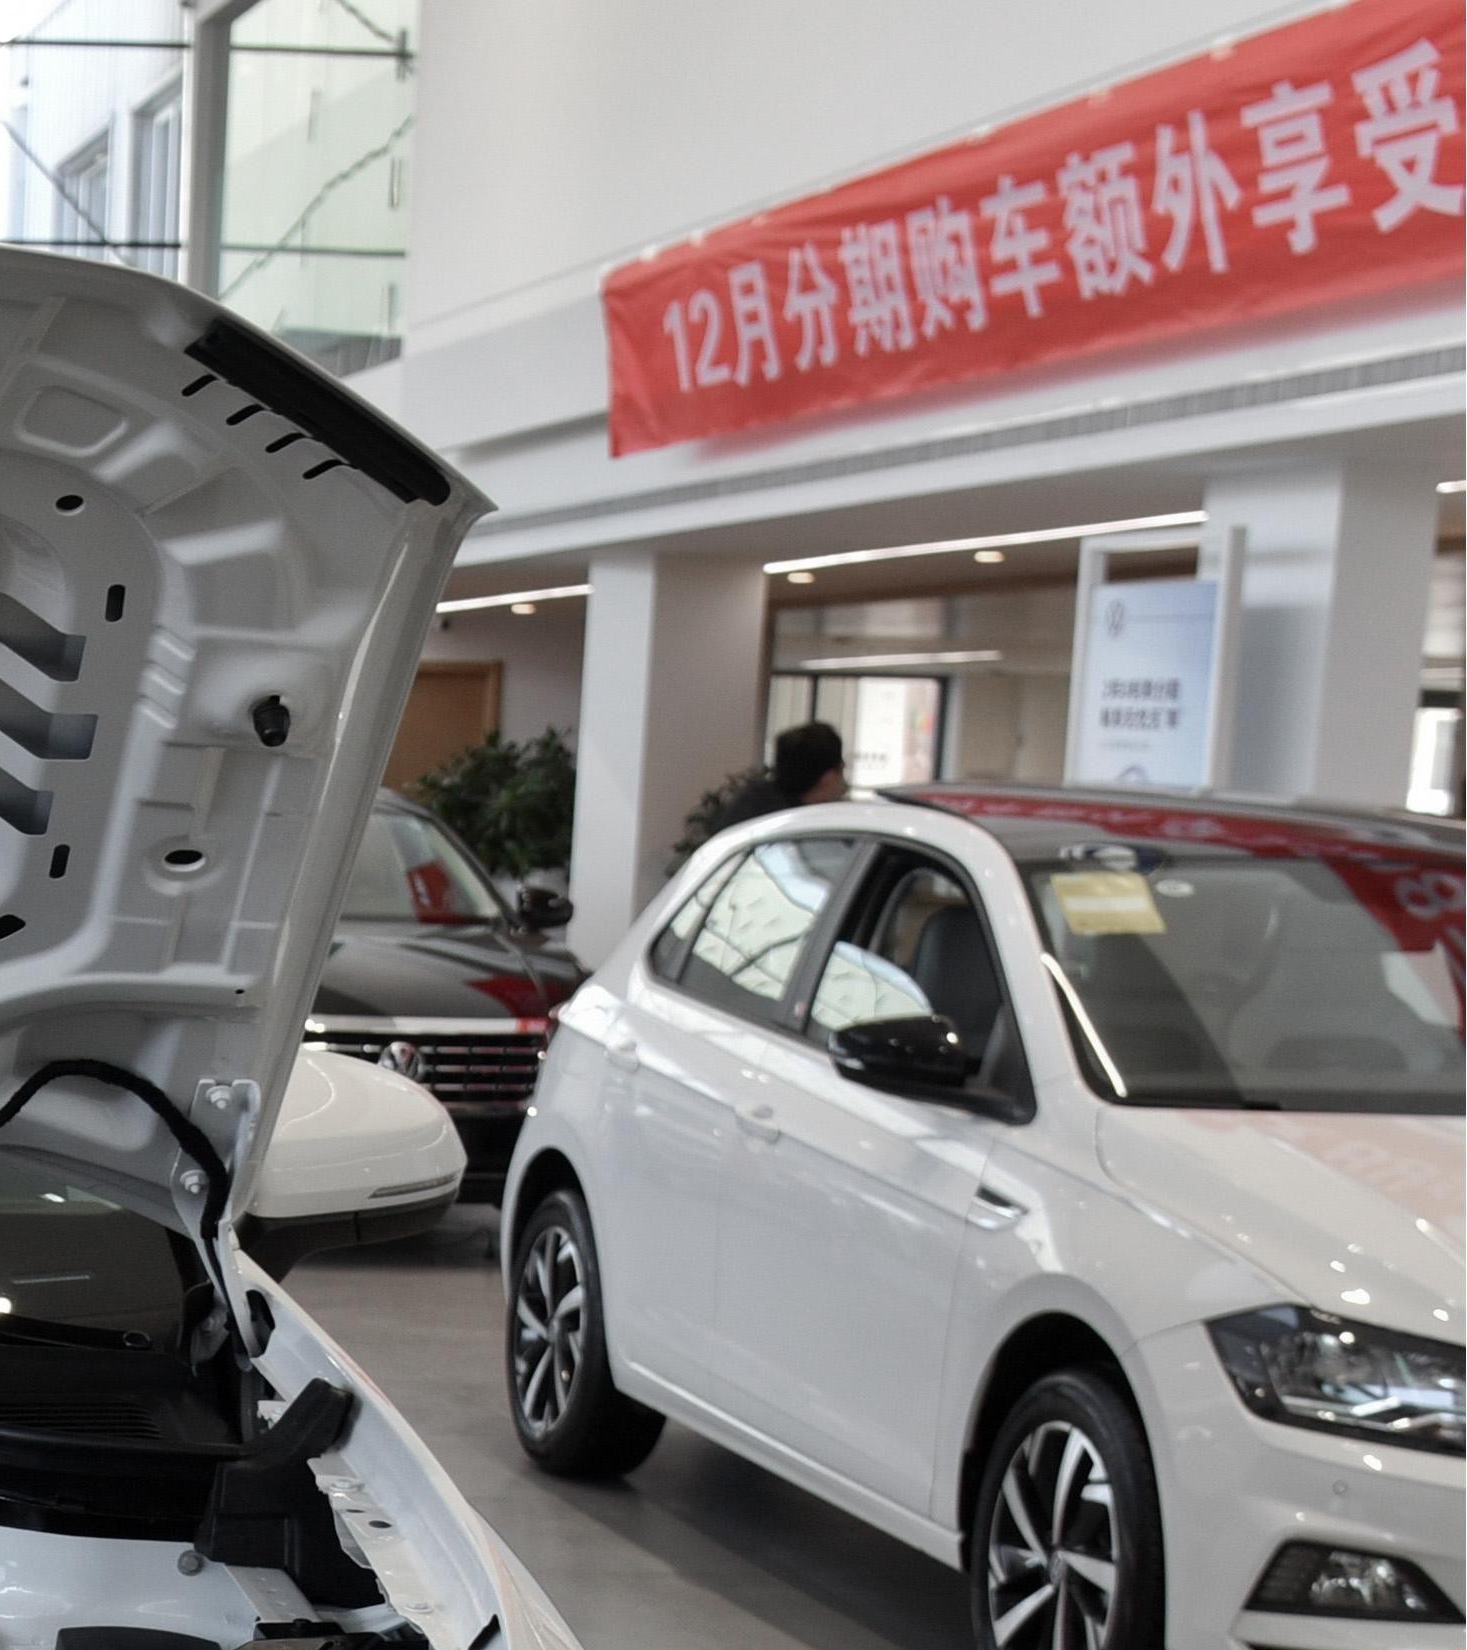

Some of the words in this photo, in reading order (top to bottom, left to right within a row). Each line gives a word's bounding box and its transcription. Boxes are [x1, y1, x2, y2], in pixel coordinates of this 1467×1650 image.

[663, 38, 1465, 393] 12月分期购车额外享受
